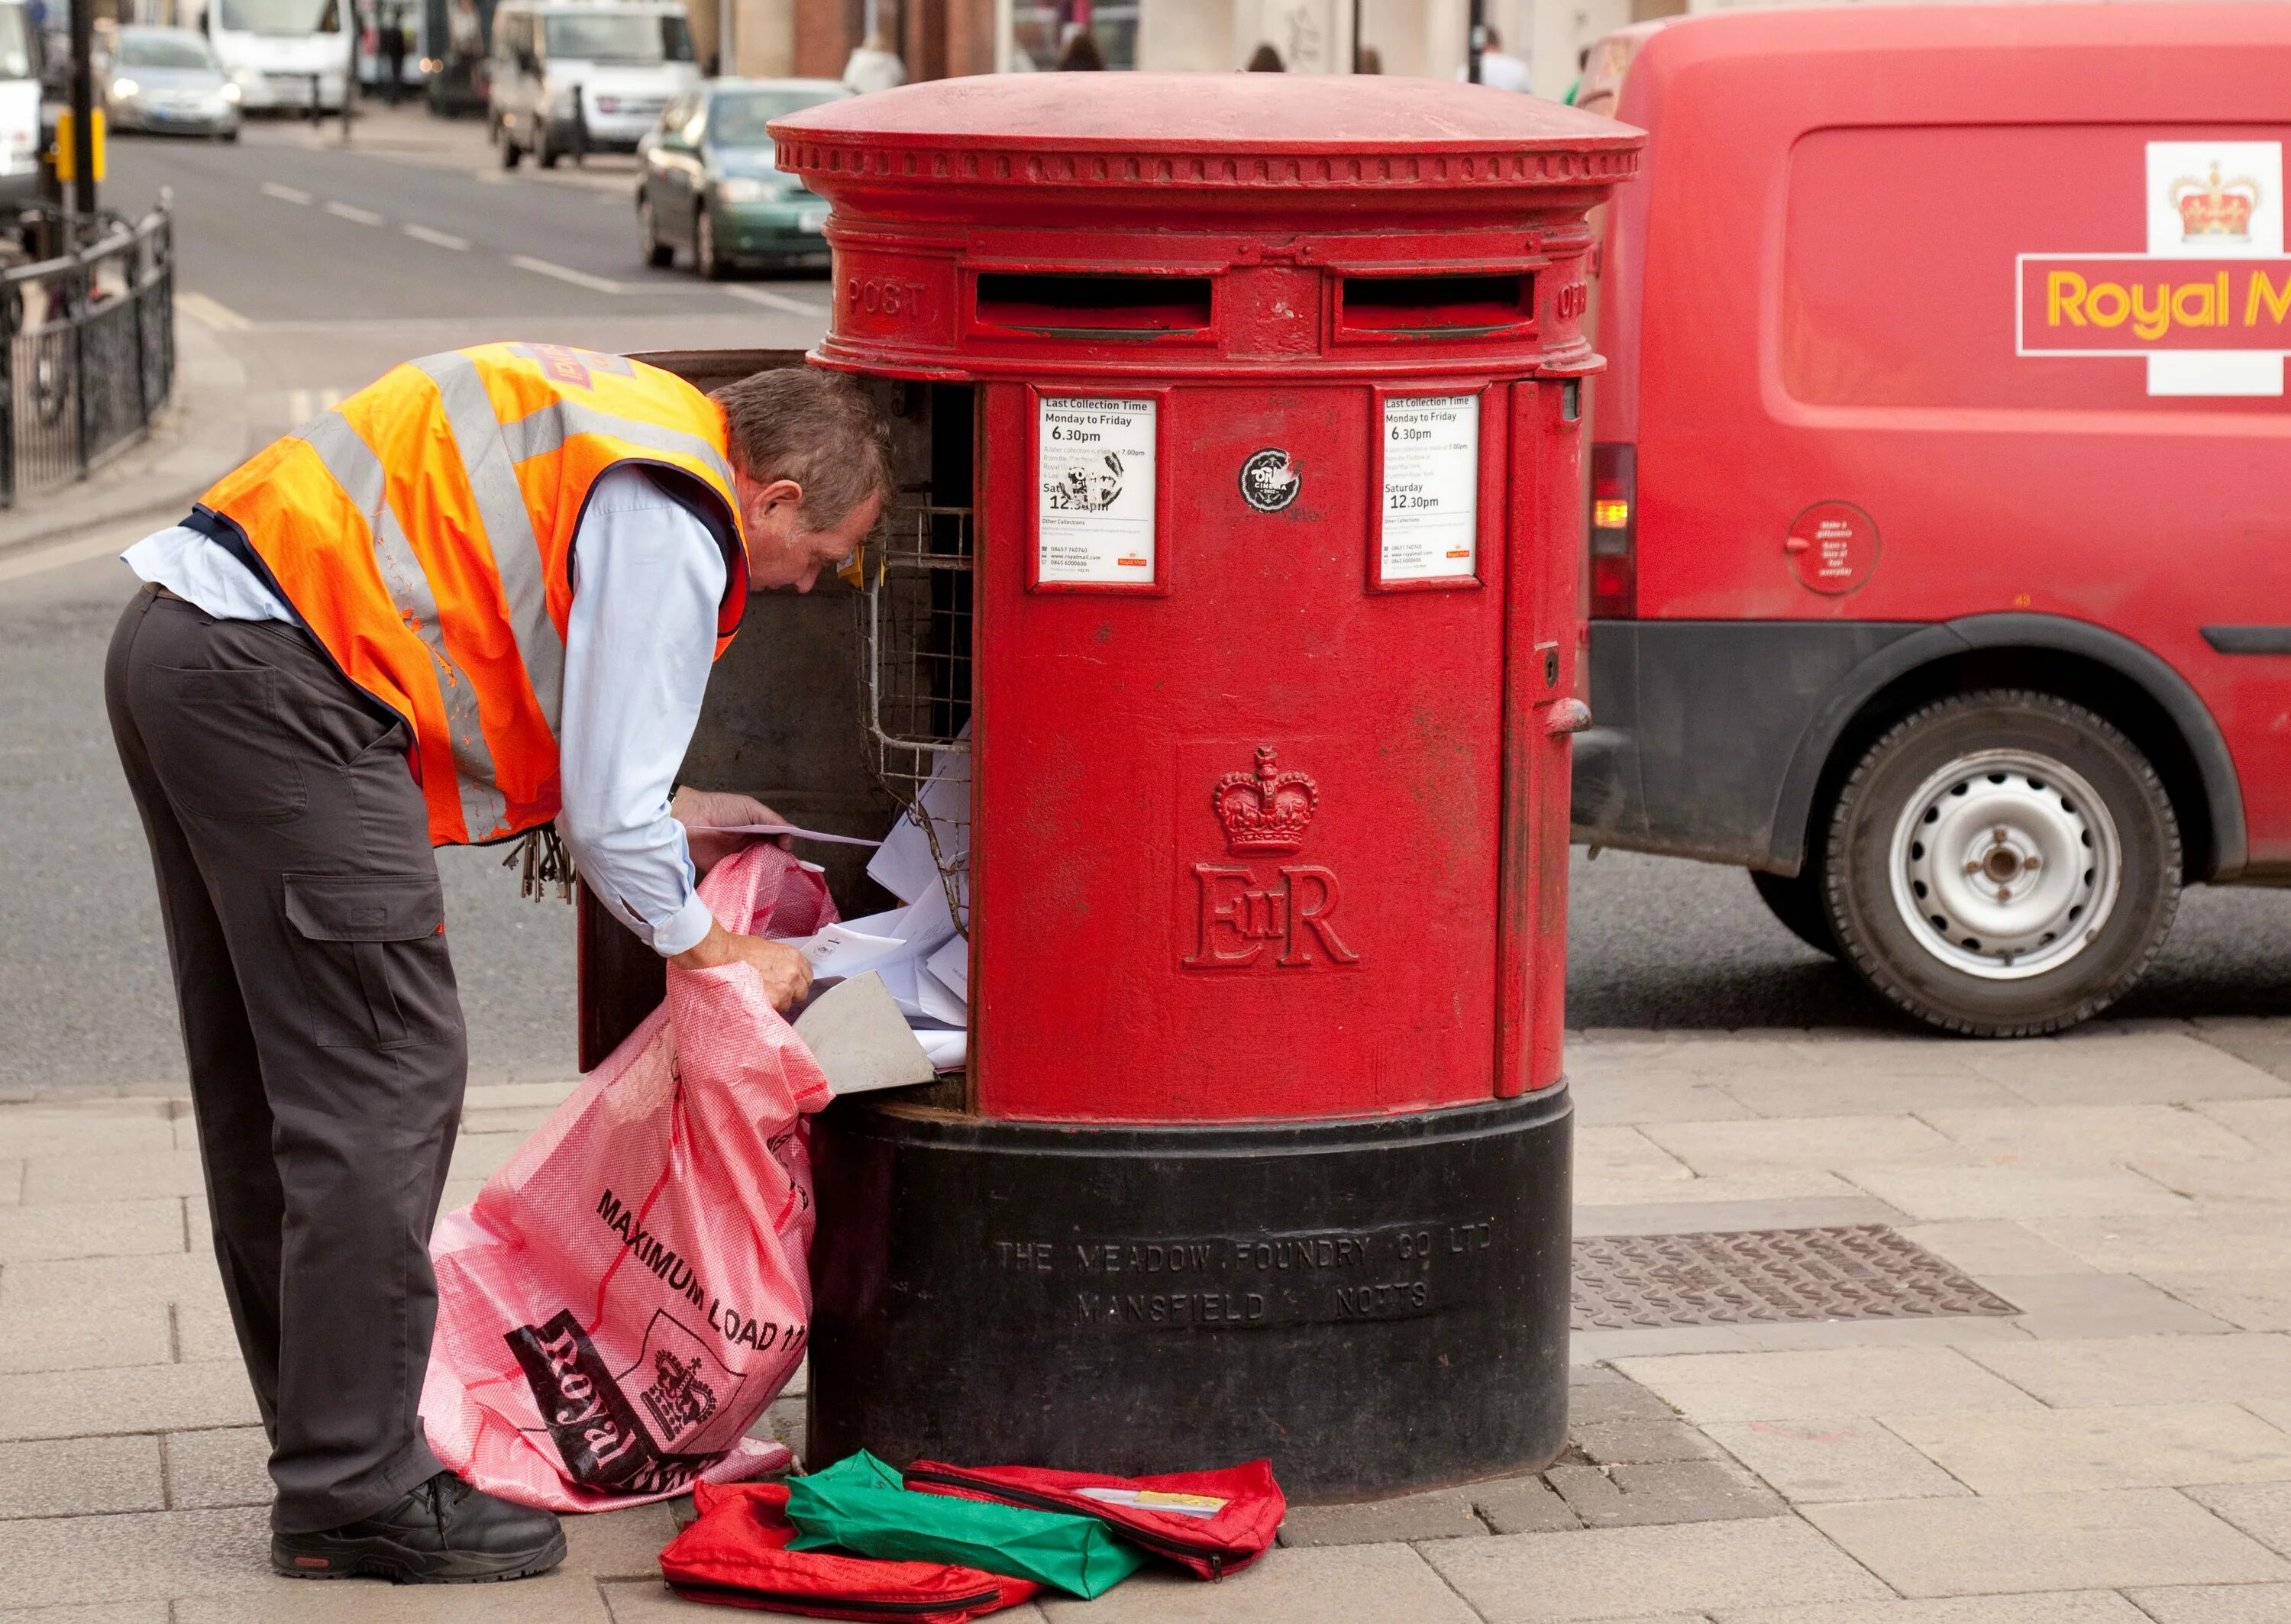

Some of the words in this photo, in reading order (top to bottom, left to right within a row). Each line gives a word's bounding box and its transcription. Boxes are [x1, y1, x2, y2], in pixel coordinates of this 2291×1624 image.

[848, 277, 926, 318] POST
[2047, 270, 2230, 341] Royal
[1045, 399, 1068, 408] Last
[1070, 399, 1120, 410] Collection
[1122, 401, 1148, 411] Time
[1386, 398, 1404, 408] Last
[1406, 397, 1446, 407] Collection
[1449, 396, 1469, 406] Time
[1045, 413, 1085, 425] Monday
[1087, 415, 1097, 425] to
[1100, 415, 1132, 428] Friday
[1385, 413, 1419, 425] Monday
[1420, 414, 1429, 422] to
[1430, 412, 1457, 422] Friday
[1052, 425, 1101, 444] 6.30pm
[1391, 425, 1433, 442] 6.30pm
[1121, 448, 1146, 457] 7.00pm
[1385, 483, 1423, 493] Saturday
[1391, 494, 1440, 510] 12.30pm
[995, 1241, 1052, 1271] THE
[1077, 1244, 1211, 1273] MEADOW
[1235, 1237, 1371, 1271] FOUNDRY
[1449, 1222, 1491, 1254] LTD
[596, 1188, 705, 1311] MAXIMUM
[707, 1298, 777, 1351] LOAD
[1078, 1293, 1264, 1324] MANSFIELD
[1336, 1281, 1427, 1316] NOTTS
[536, 1326, 638, 1471] Royal
